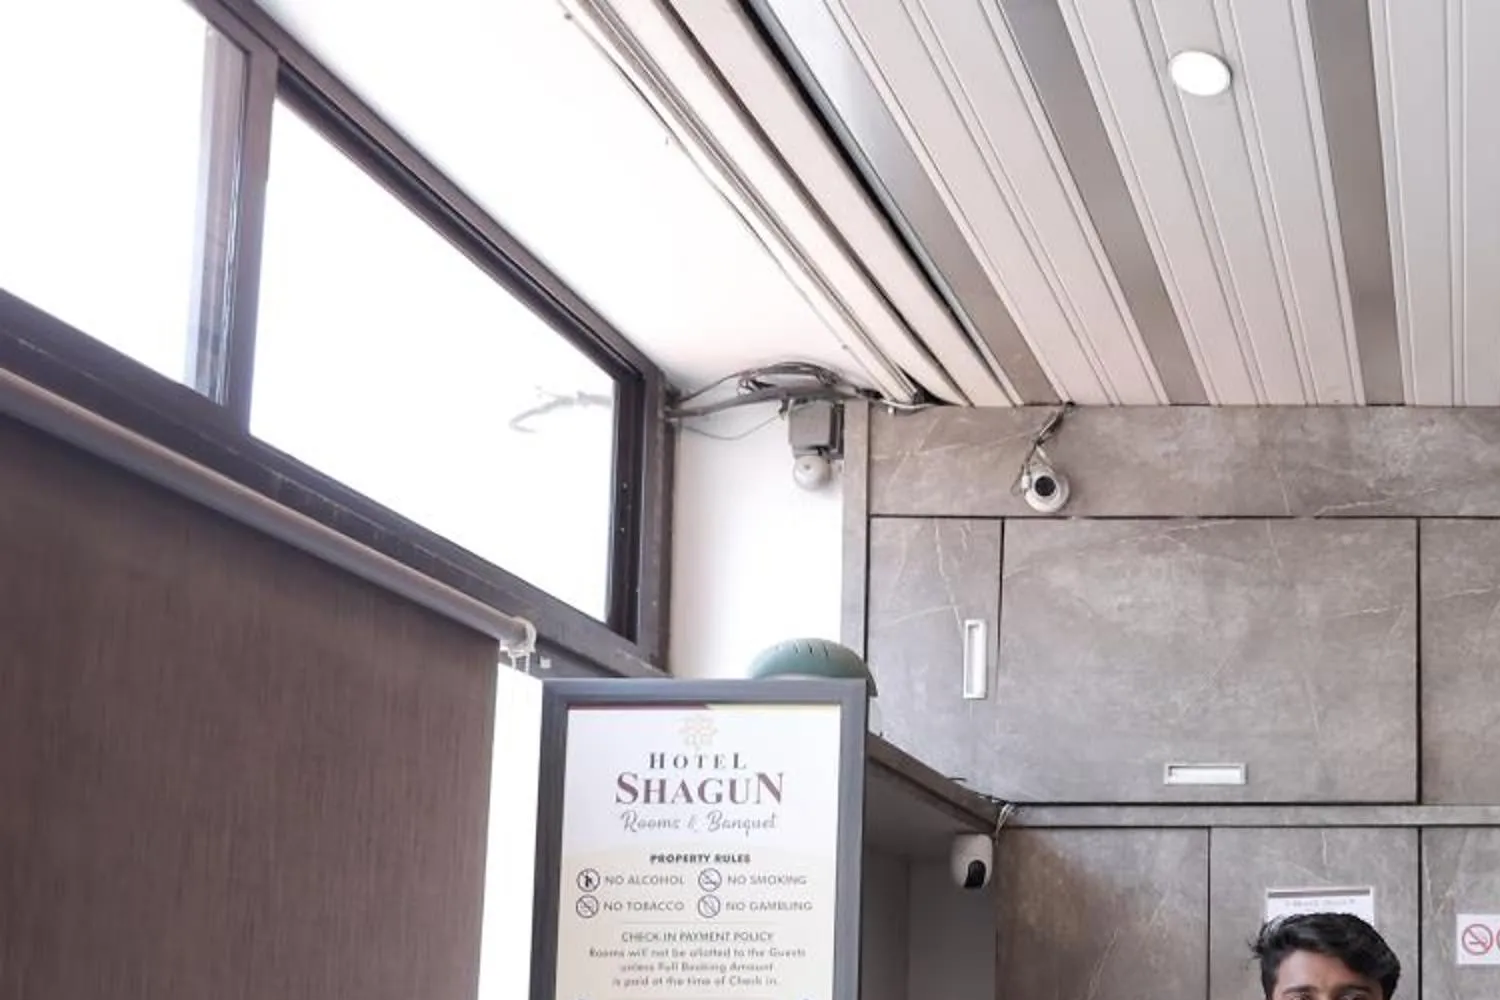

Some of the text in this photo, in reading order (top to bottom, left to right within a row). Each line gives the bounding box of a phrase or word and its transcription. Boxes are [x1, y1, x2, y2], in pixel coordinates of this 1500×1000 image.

[649, 751, 747, 769] HOTEL
[615, 771, 784, 805] SHAGUN
[620, 807, 681, 834] Rooms
[707, 808, 777, 837] Banquet
[650, 853, 751, 863] PROPERTY RULES
[605, 875, 685, 885] NO ALCOHOL
[727, 875, 807, 885] NO SMOKING
[603, 901, 684, 911] NO TOBACCO
[725, 901, 813, 911] NO GAMBLING
[621, 931, 658, 941] CHECK
[679, 931, 731, 941] PAYMENT
[733, 931, 774, 941] POLICY
[651, 947, 669, 957] not
[672, 947, 686, 957] be
[733, 947, 745, 957] to
[747, 947, 765, 957] the
[769, 947, 806, 957] Guests
